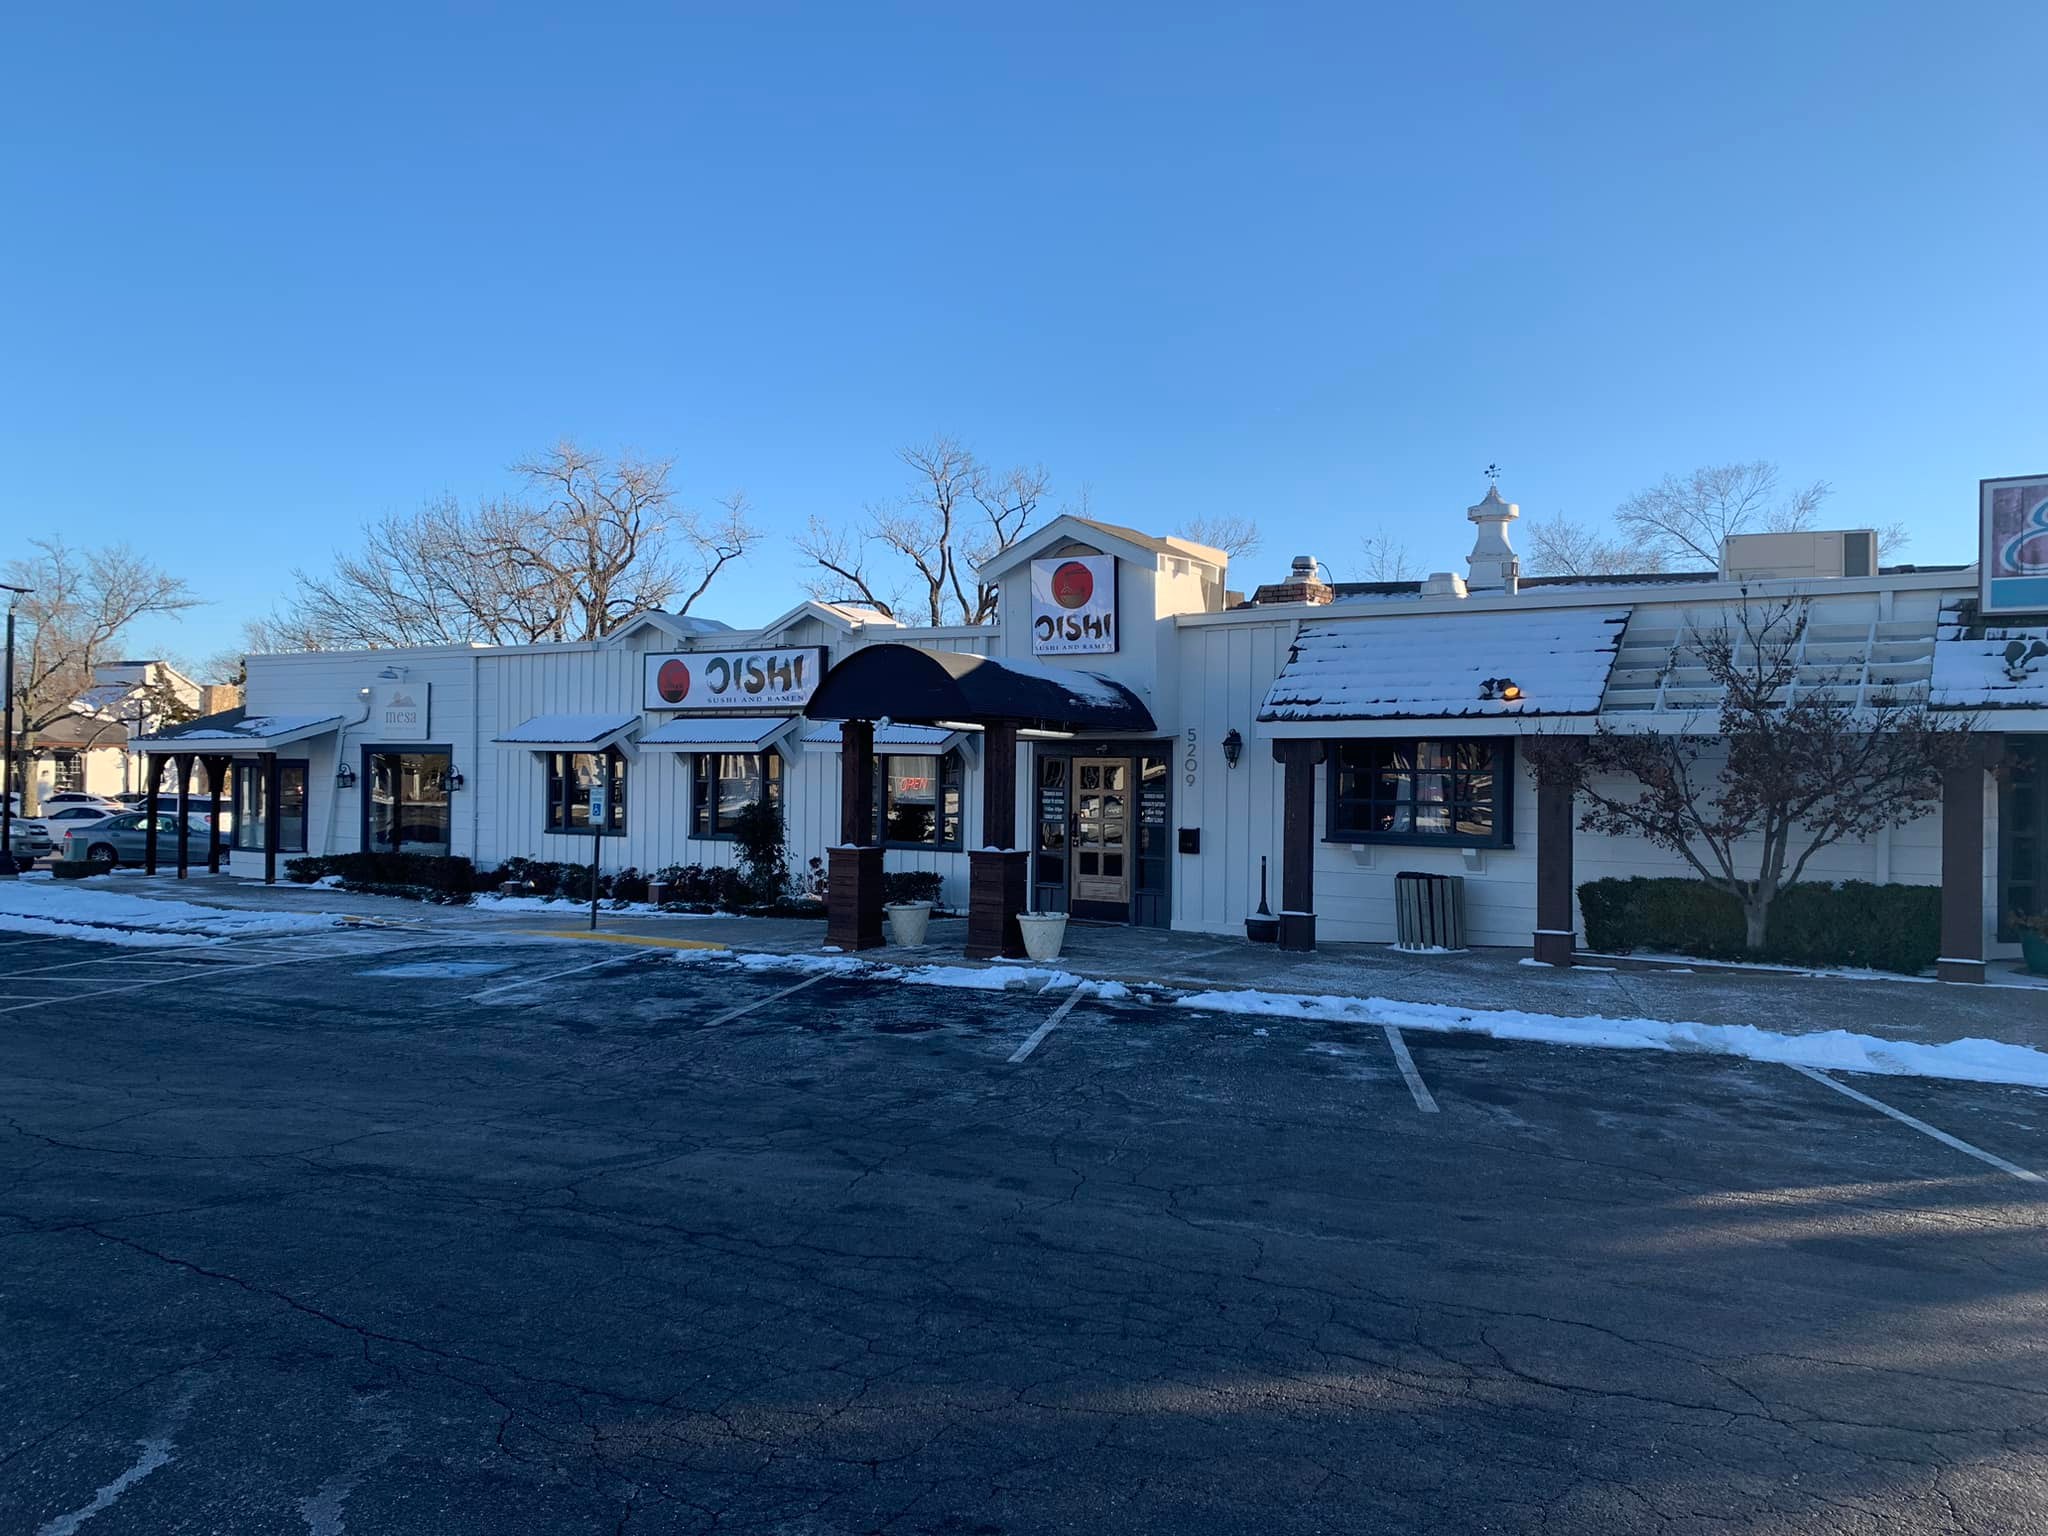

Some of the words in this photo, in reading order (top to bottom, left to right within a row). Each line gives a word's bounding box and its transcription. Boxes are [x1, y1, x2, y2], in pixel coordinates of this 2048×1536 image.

[1034, 613, 1112, 642] OISHI
[704, 655, 804, 694] OISHI
[385, 711, 416, 723] mesa
[1185, 728, 1198, 787] 5209
[901, 778, 928, 791] OPEN
